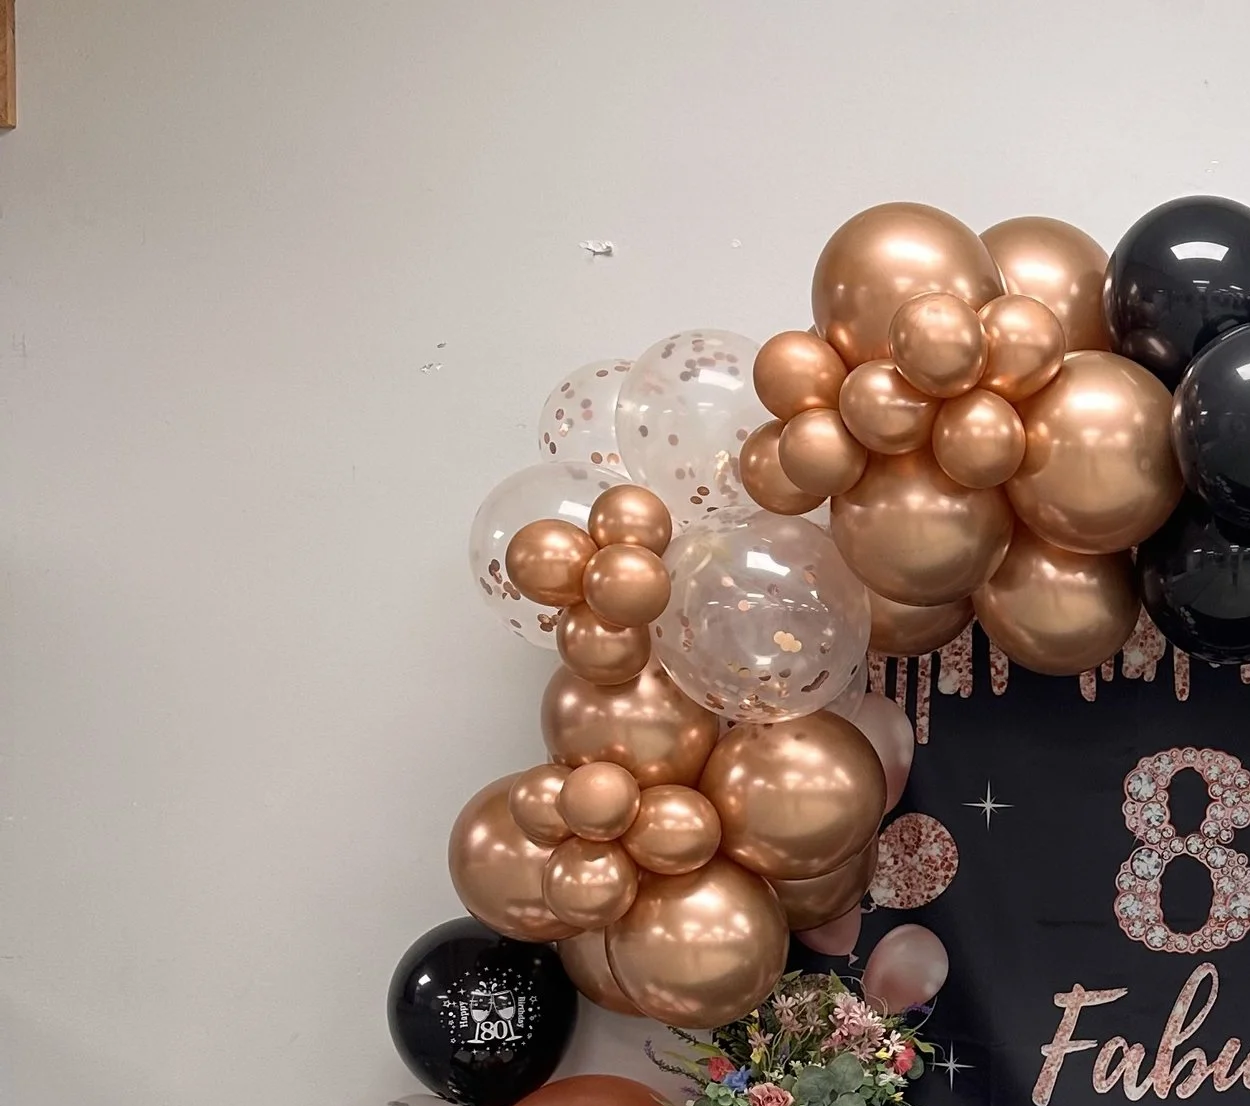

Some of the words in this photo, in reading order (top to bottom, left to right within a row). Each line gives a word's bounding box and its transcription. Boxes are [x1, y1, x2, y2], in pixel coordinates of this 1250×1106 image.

[459, 1001, 469, 1029] Happy
[516, 996, 526, 1029] Birthday
[480, 1020, 508, 1041] 80
